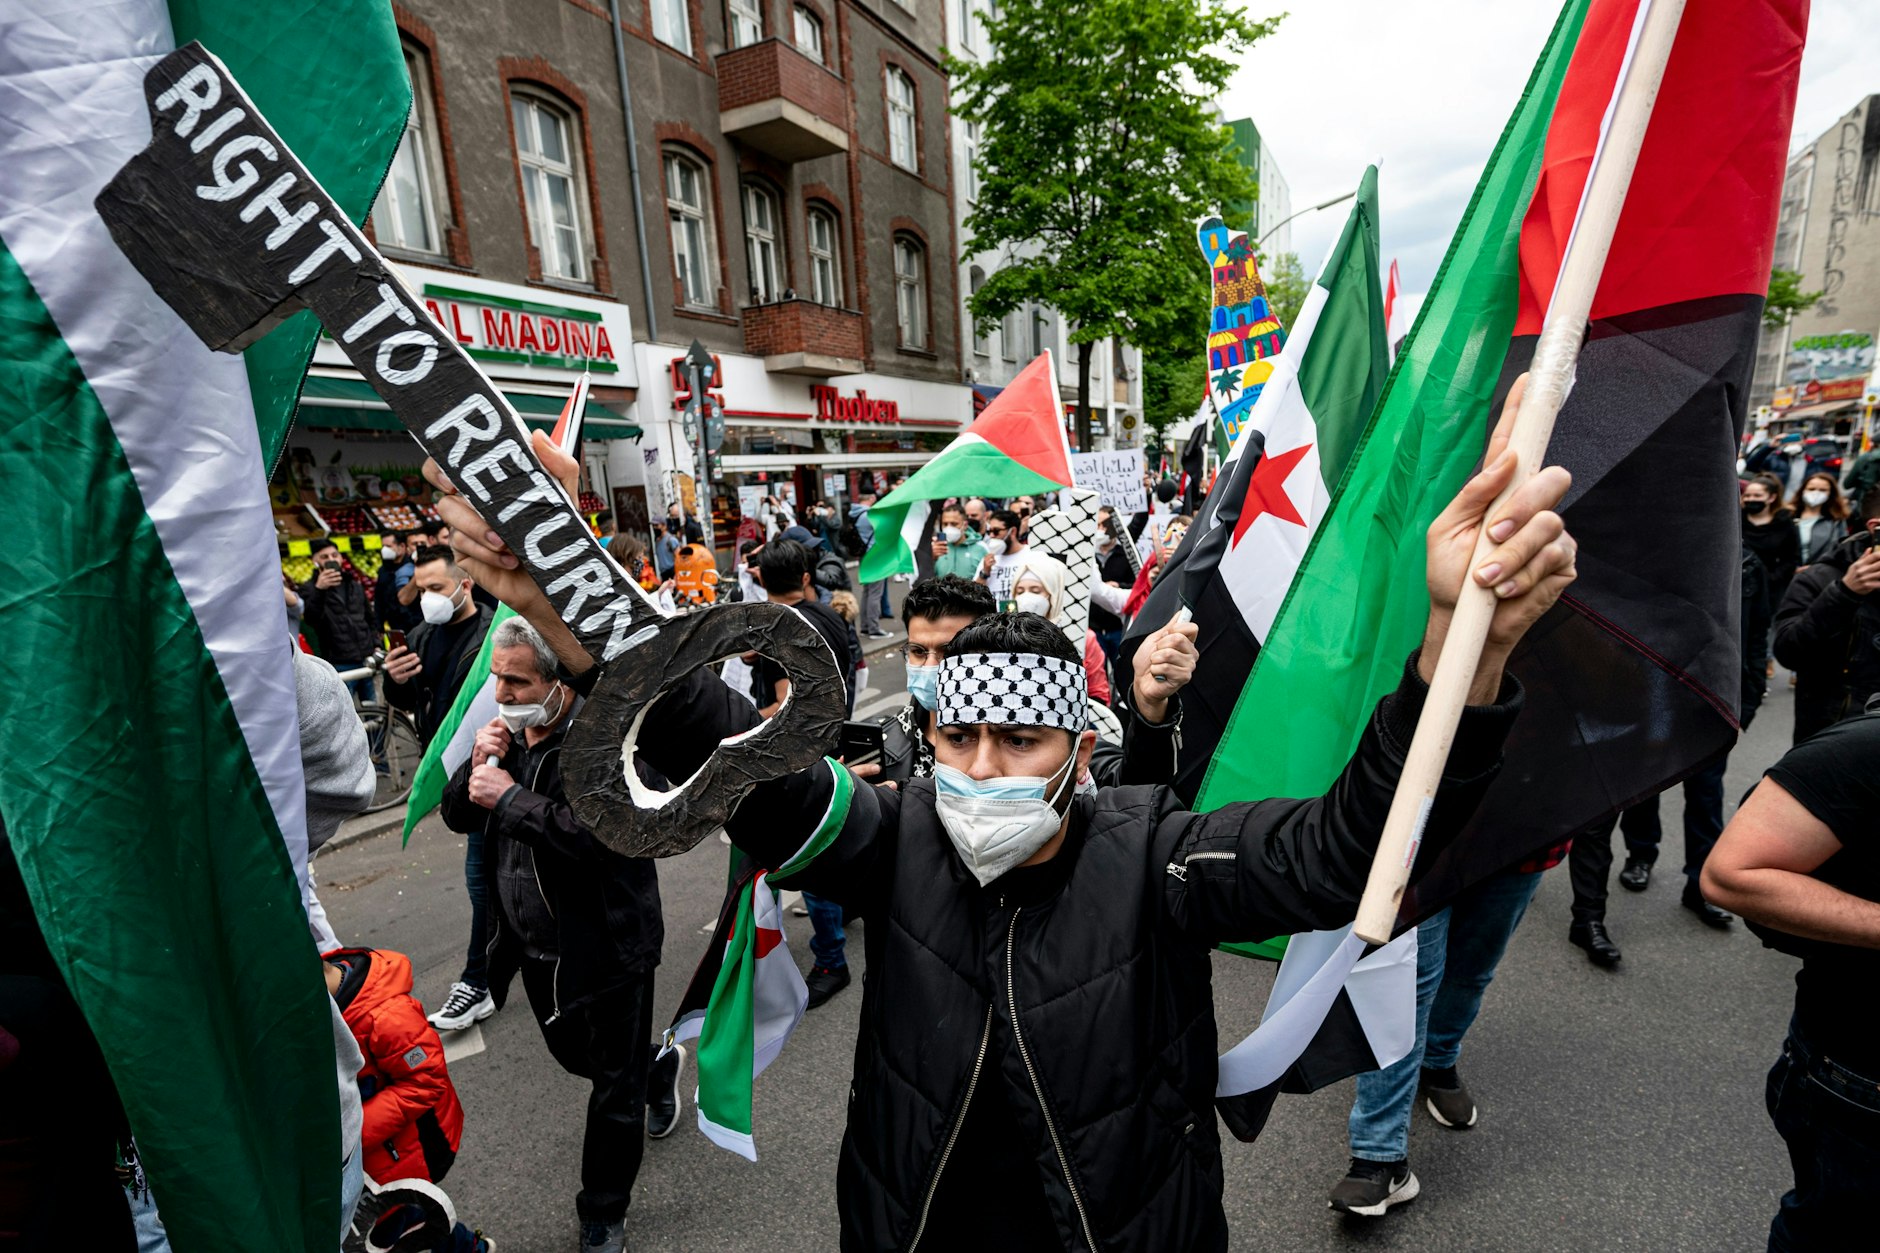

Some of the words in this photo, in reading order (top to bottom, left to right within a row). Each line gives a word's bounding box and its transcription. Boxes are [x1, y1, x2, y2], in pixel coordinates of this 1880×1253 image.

[425, 299, 474, 345] AL
[480, 306, 616, 361] MADINA
[154, 61, 362, 287] RIGHT
[343, 282, 440, 386] TO
[424, 392, 661, 662] RETURN
[810, 384, 900, 423] Thoben
[996, 567, 1018, 579] PUS
[1118, 533, 1142, 577] PALESTIN
